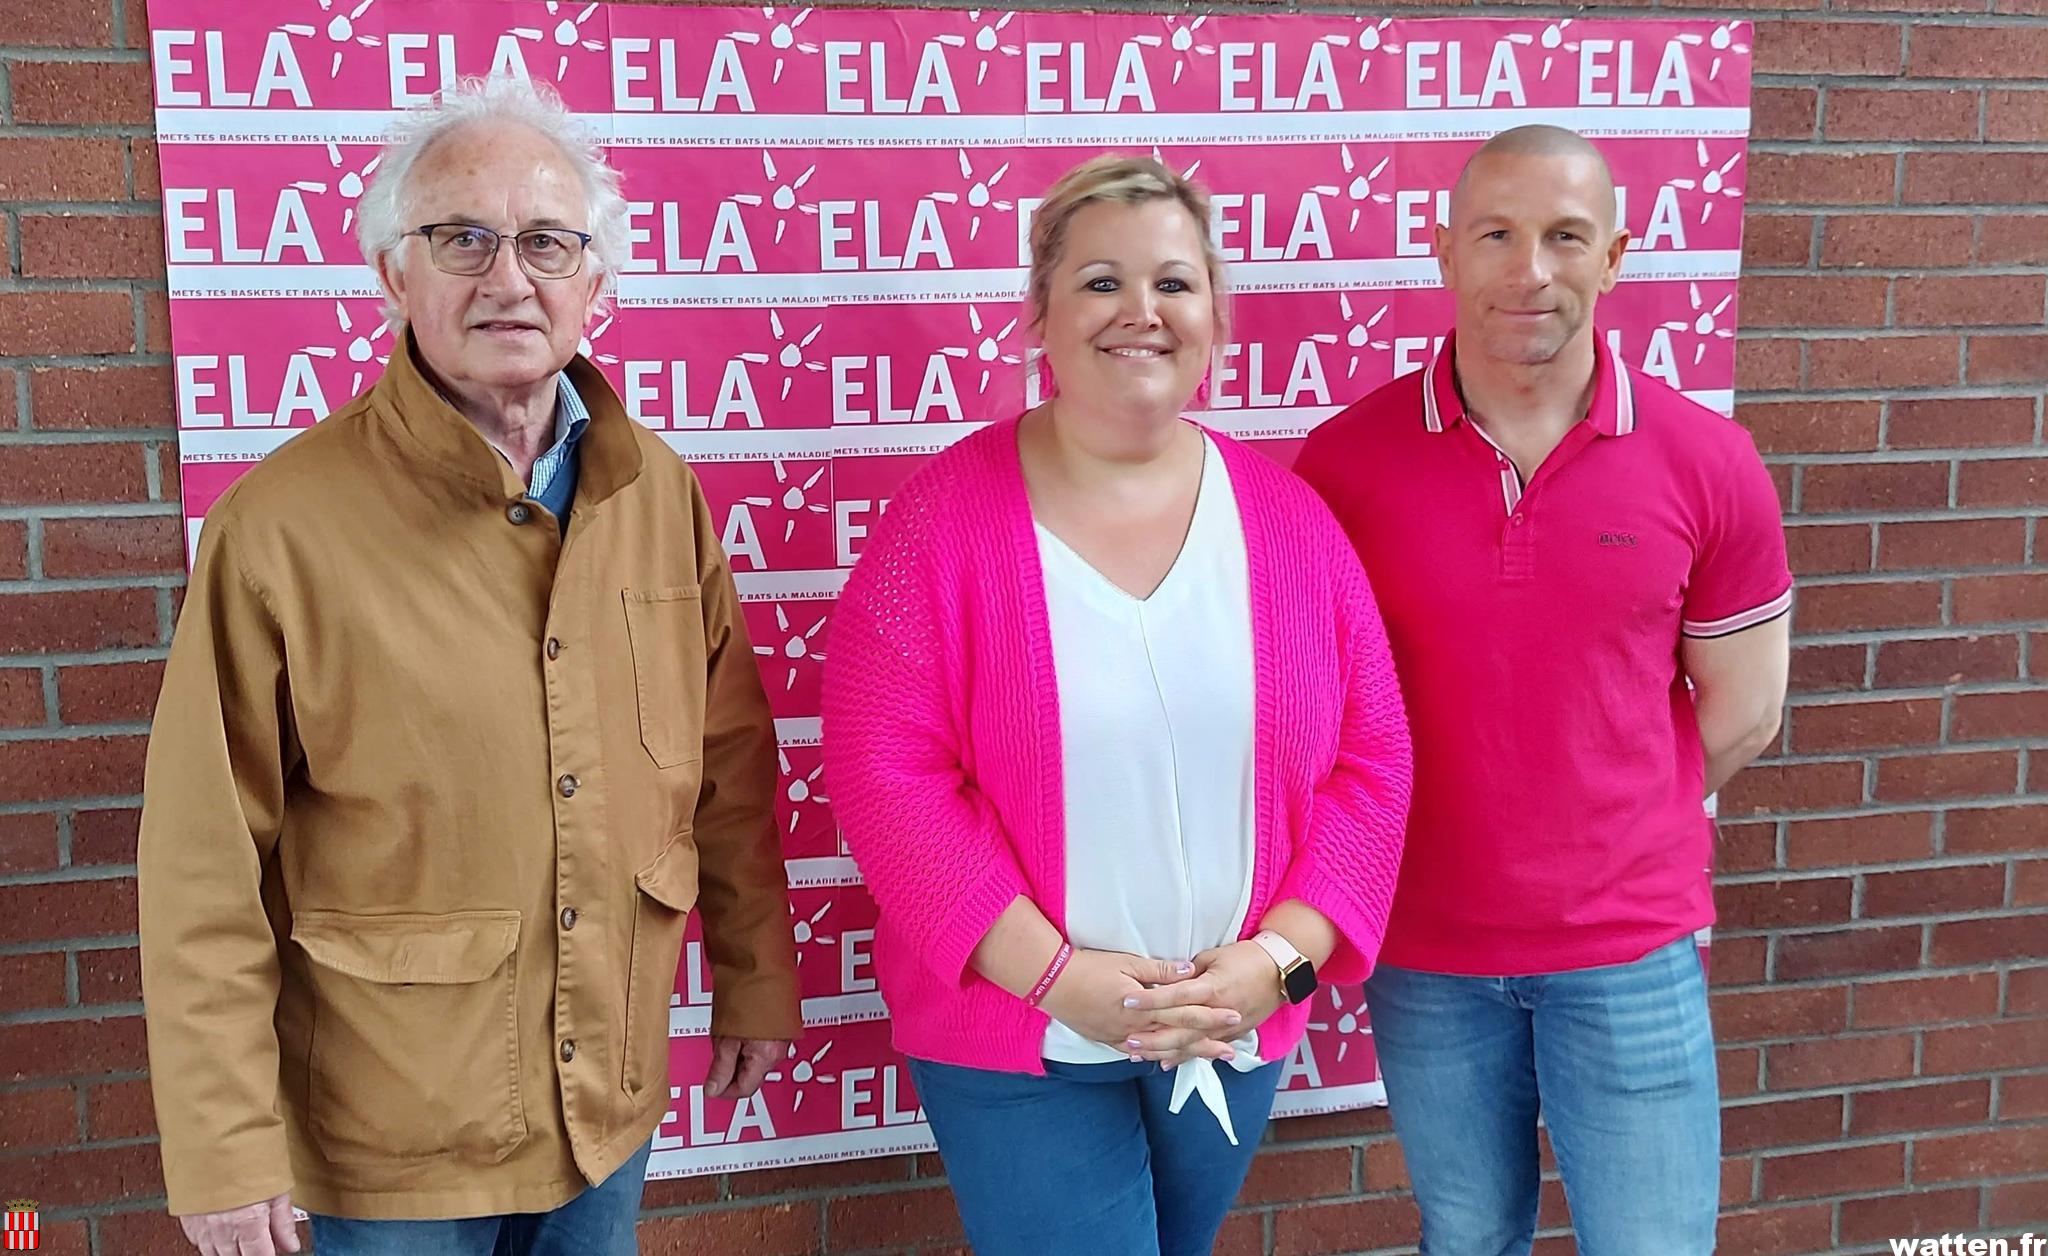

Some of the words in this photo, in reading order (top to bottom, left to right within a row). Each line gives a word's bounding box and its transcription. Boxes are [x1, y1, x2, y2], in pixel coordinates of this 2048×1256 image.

[152, 30, 313, 107] ELA
[612, 38, 756, 112] ELA
[824, 41, 961, 114] ELA
[1026, 42, 1156, 112] ELA
[1220, 42, 1343, 112] ELA
[1406, 40, 1526, 108] ELA
[1578, 40, 1694, 106] ELA
[165, 189, 324, 263] ELA
[622, 201, 758, 273] ELA
[819, 200, 954, 270] ELA
[1210, 192, 1333, 262] ELA
[1614, 186, 1687, 250] LA
[176, 354, 330, 428] ELA
[624, 360, 764, 430] ELA
[831, 354, 964, 424] ELA
[1210, 340, 1332, 408] ELA
[842, 1065, 928, 1130] EL
[647, 1170, 672, 1178] METS
[697, 1163, 739, 1173] BASKETS
[757, 1158, 780, 1167] BATS
[799, 1152, 839, 1162] MALADIE
[841, 1149, 865, 1157] METS
[889, 1144, 928, 1153] BASKETS
